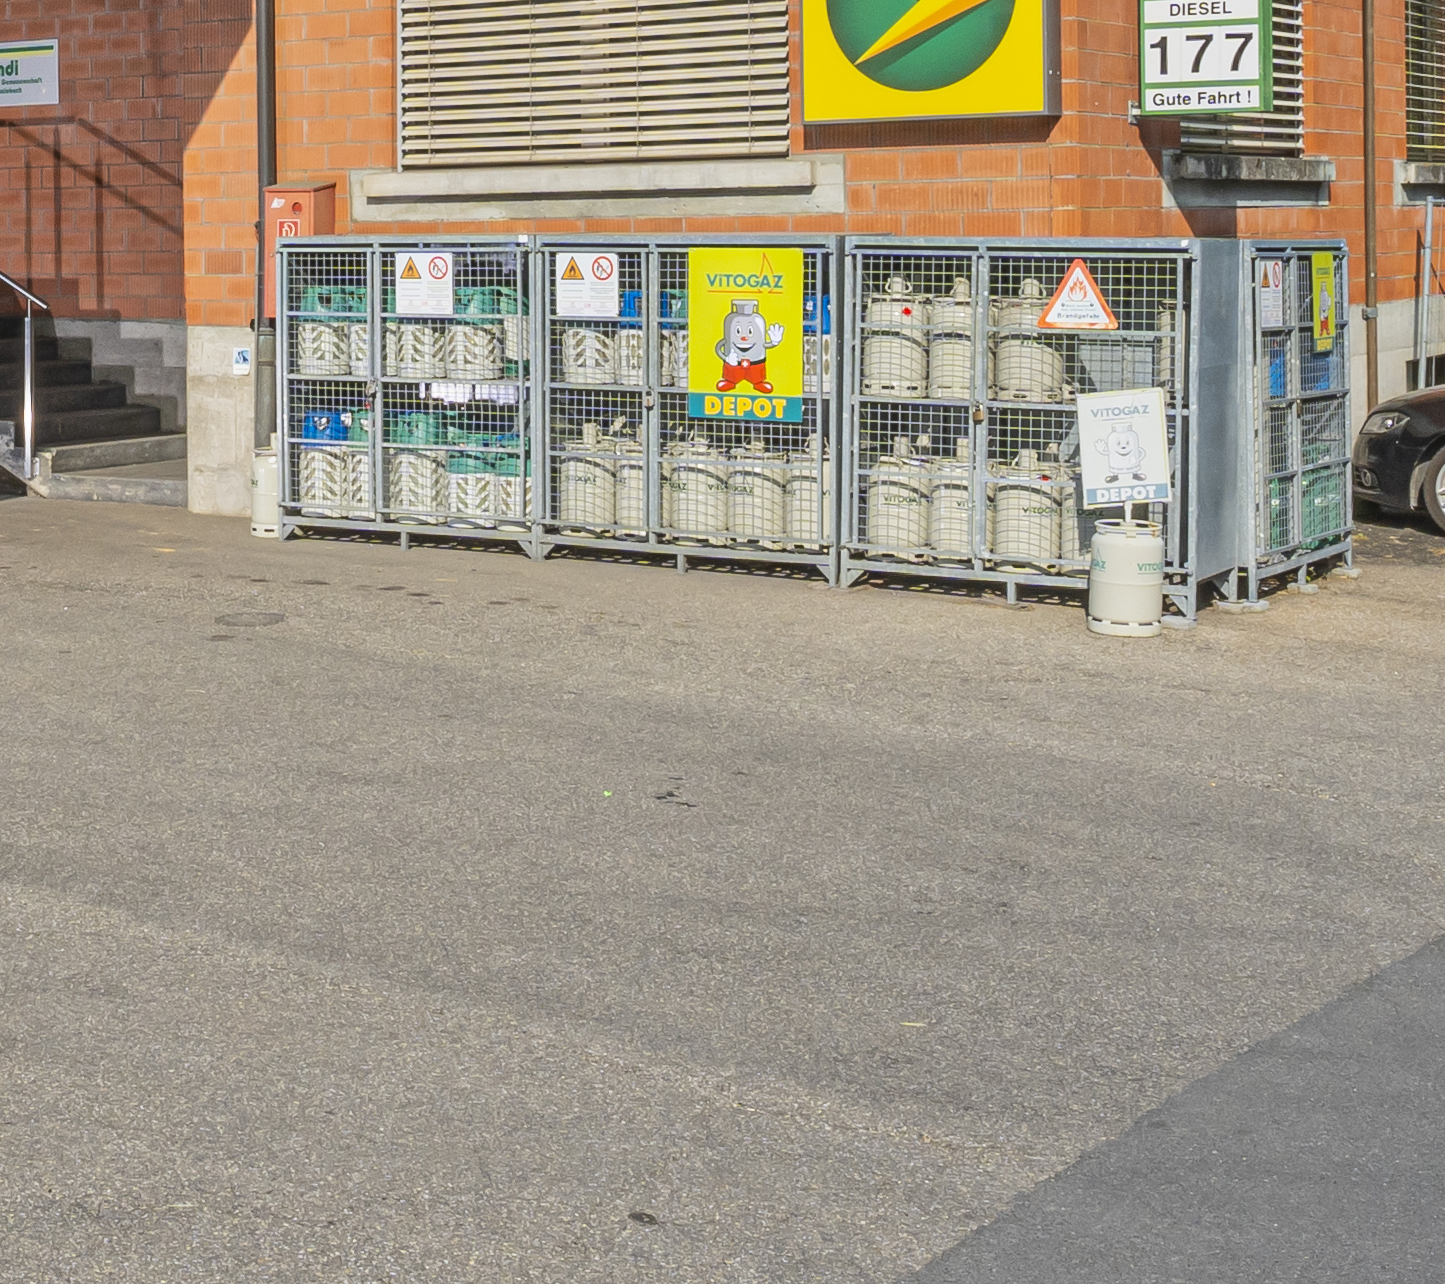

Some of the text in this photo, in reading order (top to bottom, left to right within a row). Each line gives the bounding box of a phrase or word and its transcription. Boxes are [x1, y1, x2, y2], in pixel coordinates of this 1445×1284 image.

[1169, 1, 1233, 17] DIESEL
[1149, 32, 1254, 75] 177
[1152, 92, 1192, 107] Gute
[1197, 90, 1242, 105] Fahrt
[704, 395, 787, 419] DEPOT
[1095, 485, 1157, 503] DEPOT
